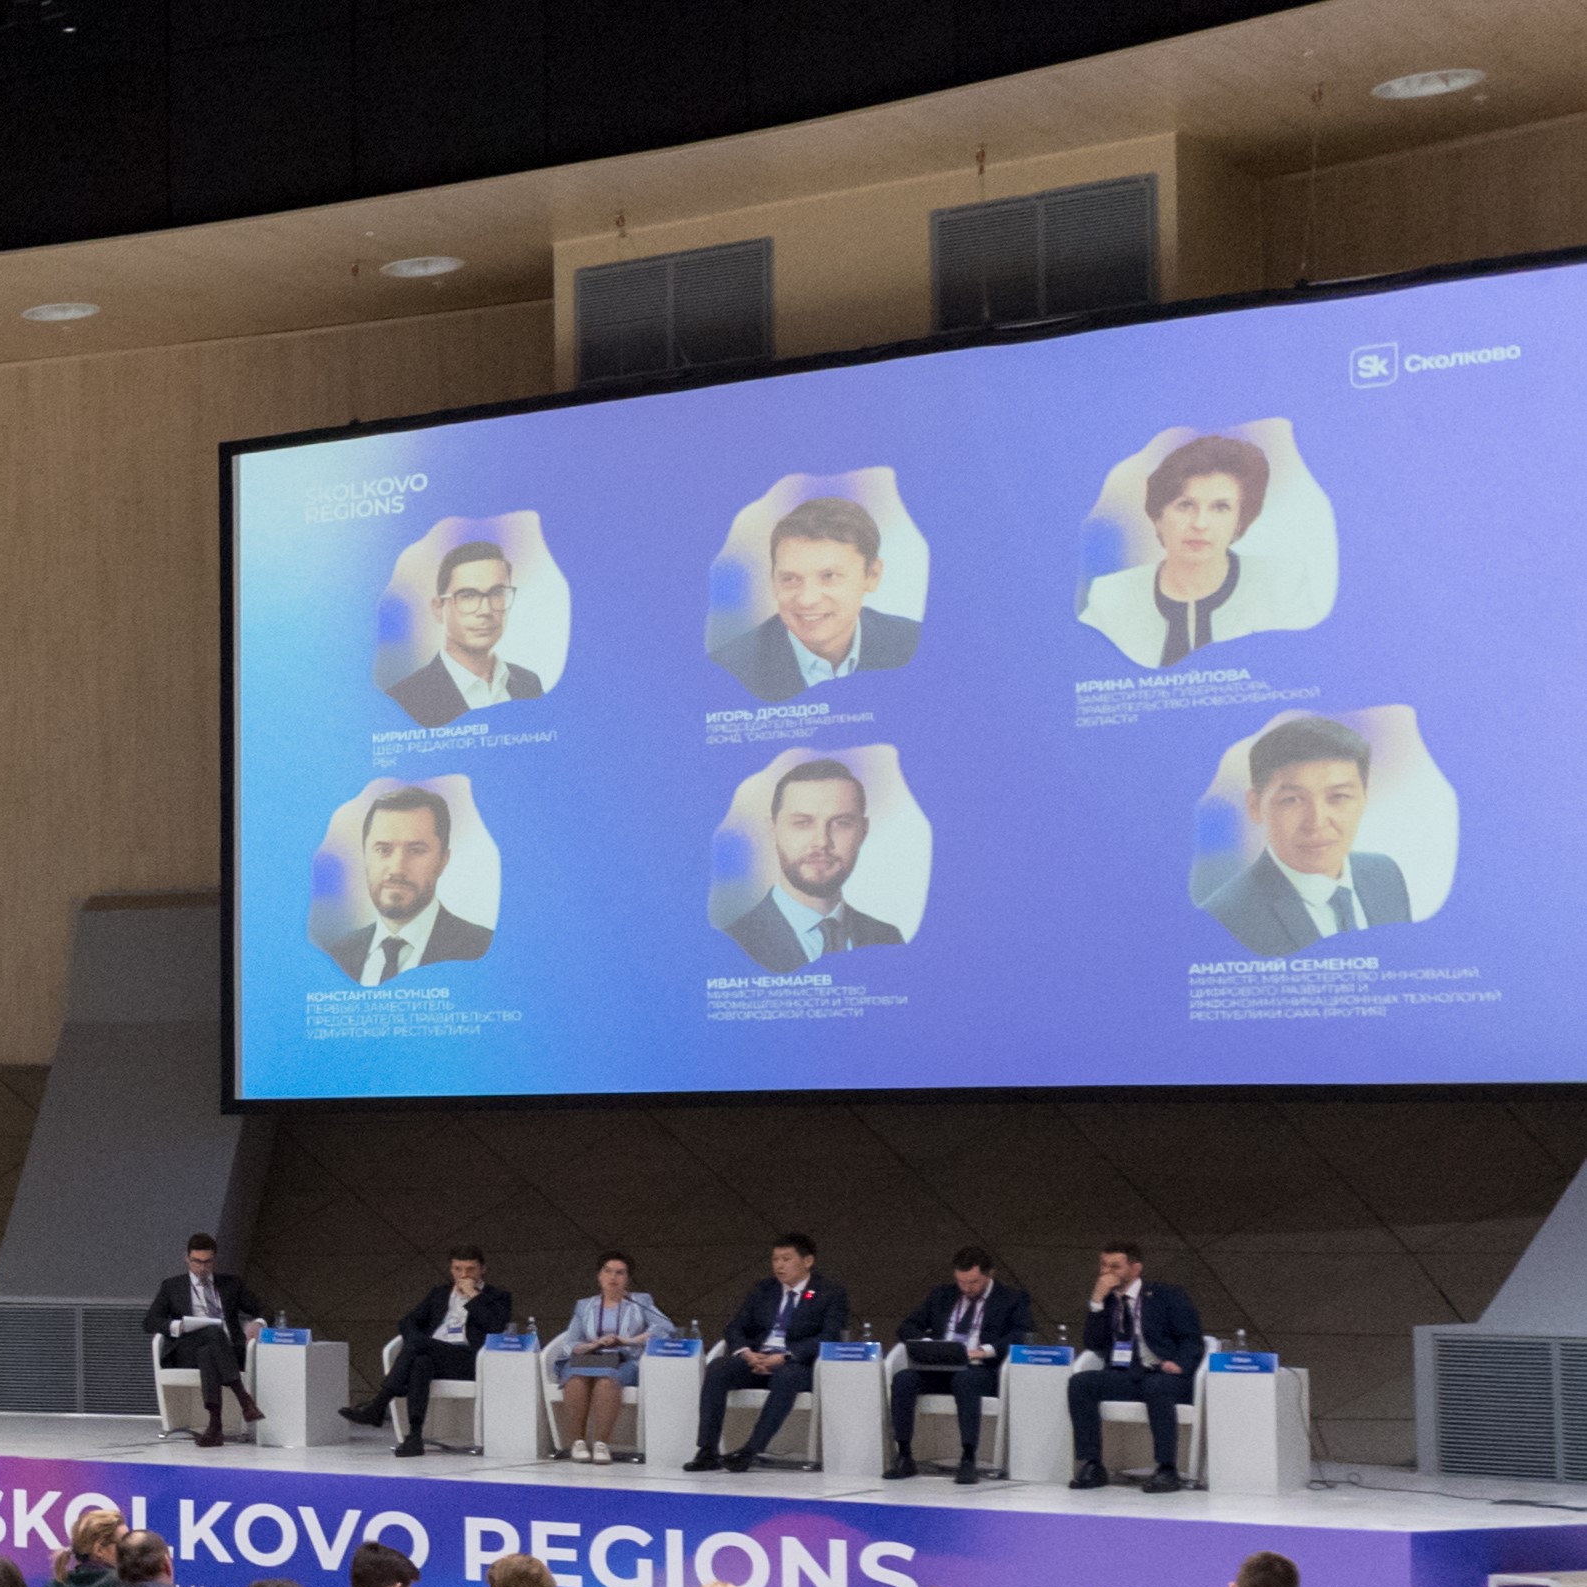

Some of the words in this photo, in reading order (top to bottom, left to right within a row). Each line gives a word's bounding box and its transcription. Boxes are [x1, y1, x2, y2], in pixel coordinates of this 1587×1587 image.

[1357, 354, 1390, 378] Sk
[1404, 344, 1522, 373] Сколково
[306, 473, 428, 503] SKOLKOVO
[305, 495, 405, 524] REGIONS
[1075, 678, 1135, 693] ИРИНА
[1138, 668, 1251, 687] МАНУЙЛОВА
[705, 710, 754, 723] ИГОРЬ
[755, 702, 830, 721] ДРОЗДОВ
[372, 729, 426, 743] КИРИЛЛ
[429, 723, 489, 738] ТОКАРЕВ
[1188, 957, 1287, 974] АНАТОЛИЙ
[1290, 956, 1379, 972] СЕМЕНОВ
[707, 977, 748, 989] ИВАН
[751, 974, 832, 988] ЧЕКМАРЕВ
[306, 990, 392, 1002] КОНСТАНТИН
[394, 987, 450, 1000] СУНЦОВ
